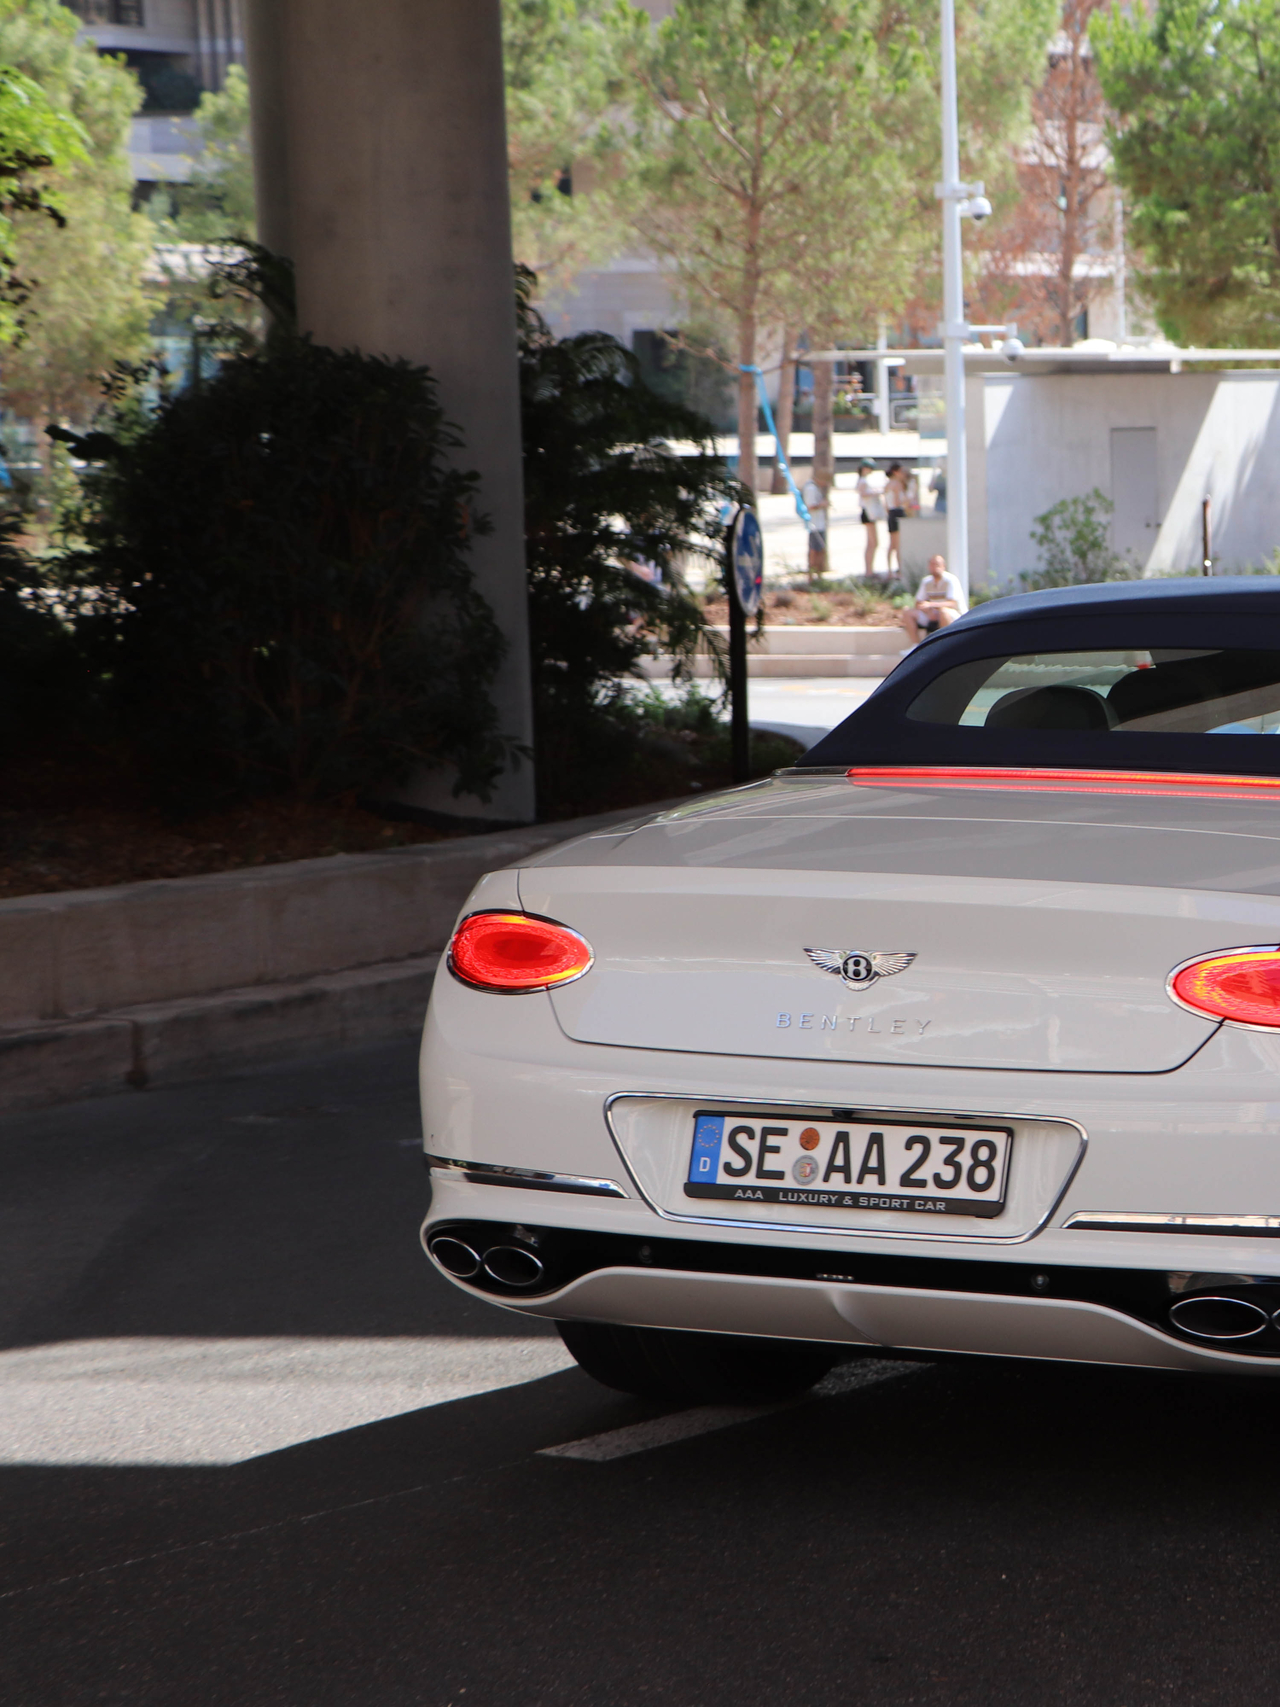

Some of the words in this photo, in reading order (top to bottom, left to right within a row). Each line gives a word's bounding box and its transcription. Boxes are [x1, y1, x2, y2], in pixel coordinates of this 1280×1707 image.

[848, 956, 868, 980] B
[776, 1012, 932, 1035] BENTLEY
[699, 1157, 711, 1172] D
[723, 1125, 789, 1181] SE
[823, 1131, 886, 1186] AA
[900, 1135, 997, 1193] 238
[734, 1189, 764, 1200] AAA
[779, 1192, 839, 1206] LUXURY
[843, 1194, 853, 1206] &
[858, 1196, 911, 1210] SPORT
[915, 1200, 946, 1211] CAR
